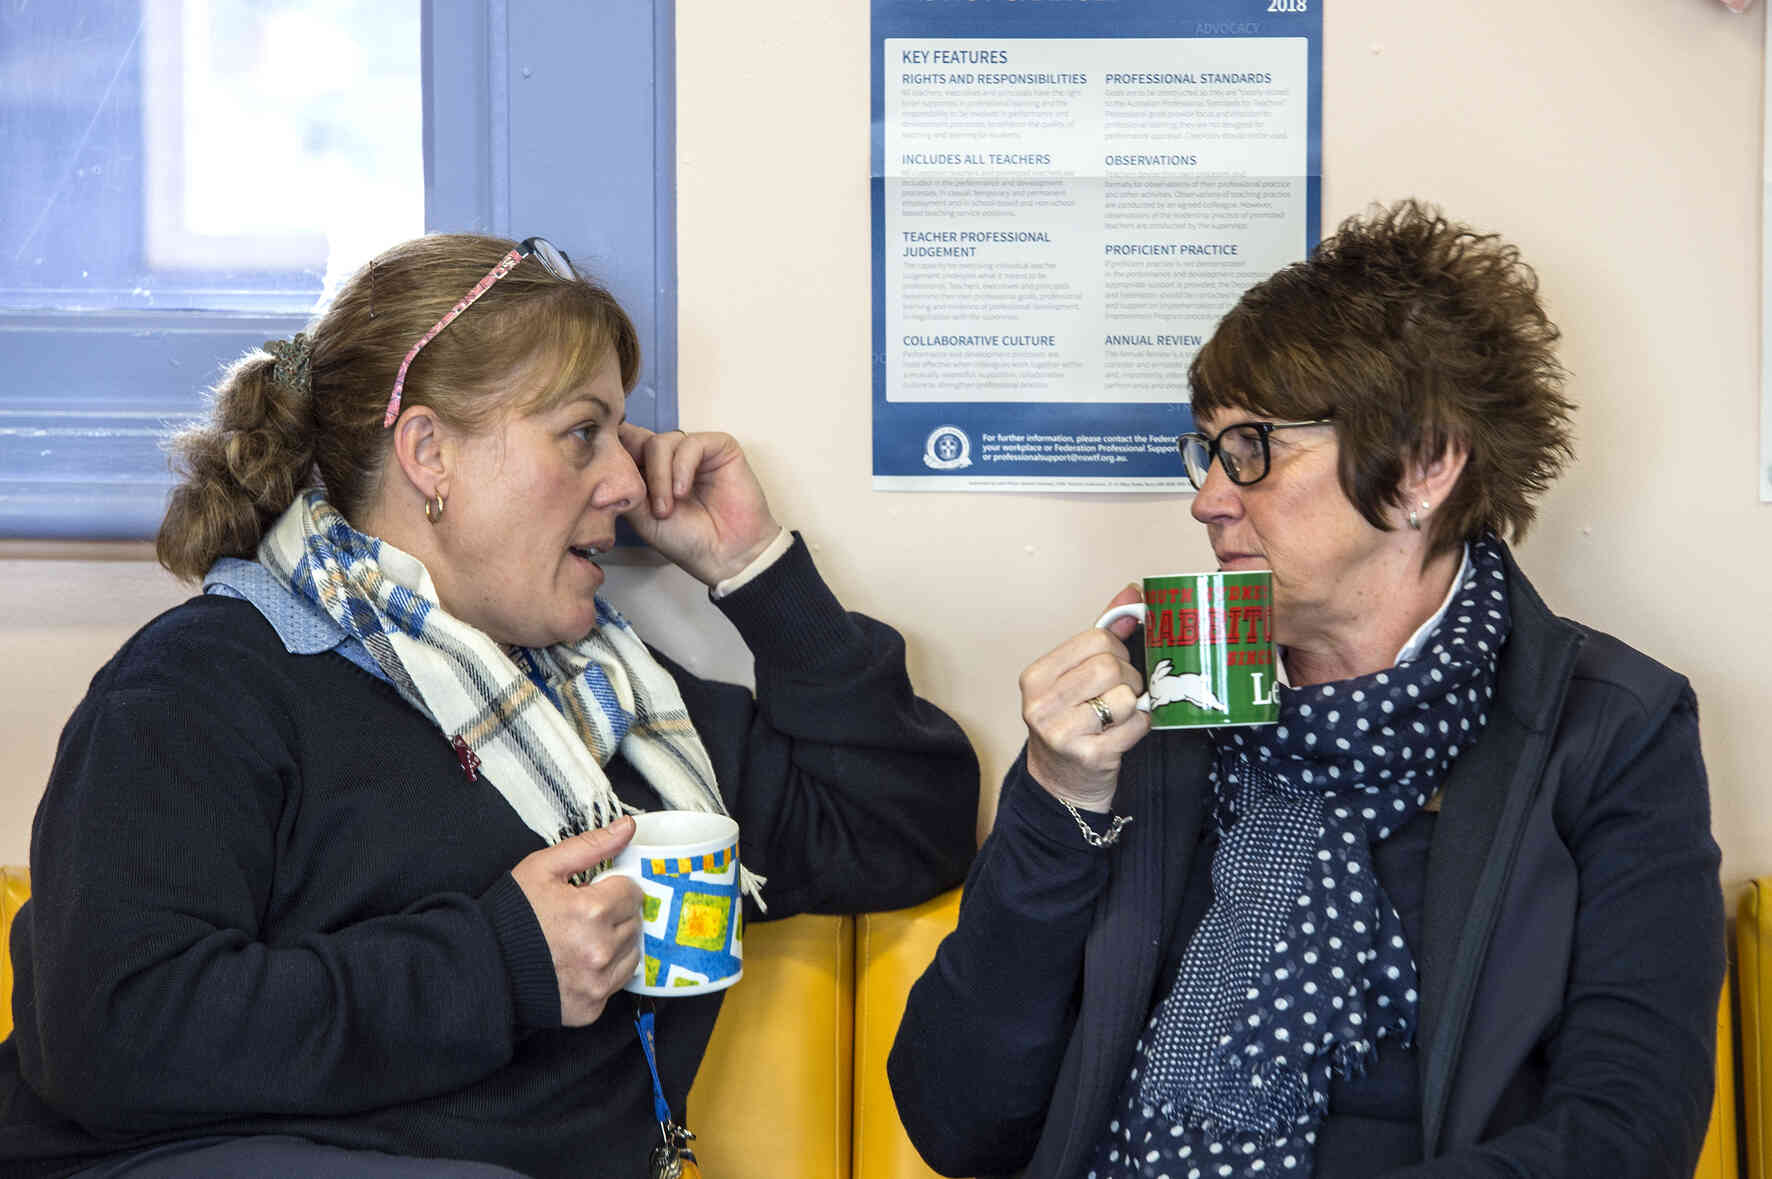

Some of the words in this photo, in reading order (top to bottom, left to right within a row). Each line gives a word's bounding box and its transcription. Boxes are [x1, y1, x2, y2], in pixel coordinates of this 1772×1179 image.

[1267, 0, 1308, 12] 2018
[902, 50, 929, 64] KEY
[933, 50, 1009, 64] FEATURES
[902, 73, 946, 84] RIGHTS
[949, 73, 974, 84] AND
[978, 73, 1088, 84] RESPONSIBILITIES
[1105, 73, 1197, 84] PROFESSIONAL
[1200, 73, 1272, 84] STANDARDS
[902, 154, 962, 165] INCLUDES
[964, 154, 985, 165] ALL
[989, 154, 1051, 165] TEACHERS
[1105, 155, 1197, 166] OBSERVATIONS
[902, 231, 957, 242] TEACHER
[960, 231, 1051, 242] PROFESSIONAL
[902, 247, 976, 257] JUDGEMENT
[1105, 245, 1176, 256] PROFICIENT
[1180, 245, 1239, 256] PRACTICE
[903, 335, 999, 346] COLLABORATIVE
[1002, 335, 1055, 346] CULTURE
[1105, 335, 1153, 345] ANNUAL
[1157, 335, 1202, 345] REVIEW
[983, 433, 995, 441] For
[998, 433, 1024, 441] further
[1027, 434, 1074, 442] information,
[1076, 434, 1101, 444] please
[1104, 434, 1132, 442] contact
[1134, 434, 1147, 442] the
[983, 444, 1000, 453] your
[1003, 443, 1041, 454] workplace
[1055, 443, 1096, 451] Federation
[1098, 444, 1145, 452] Professional
